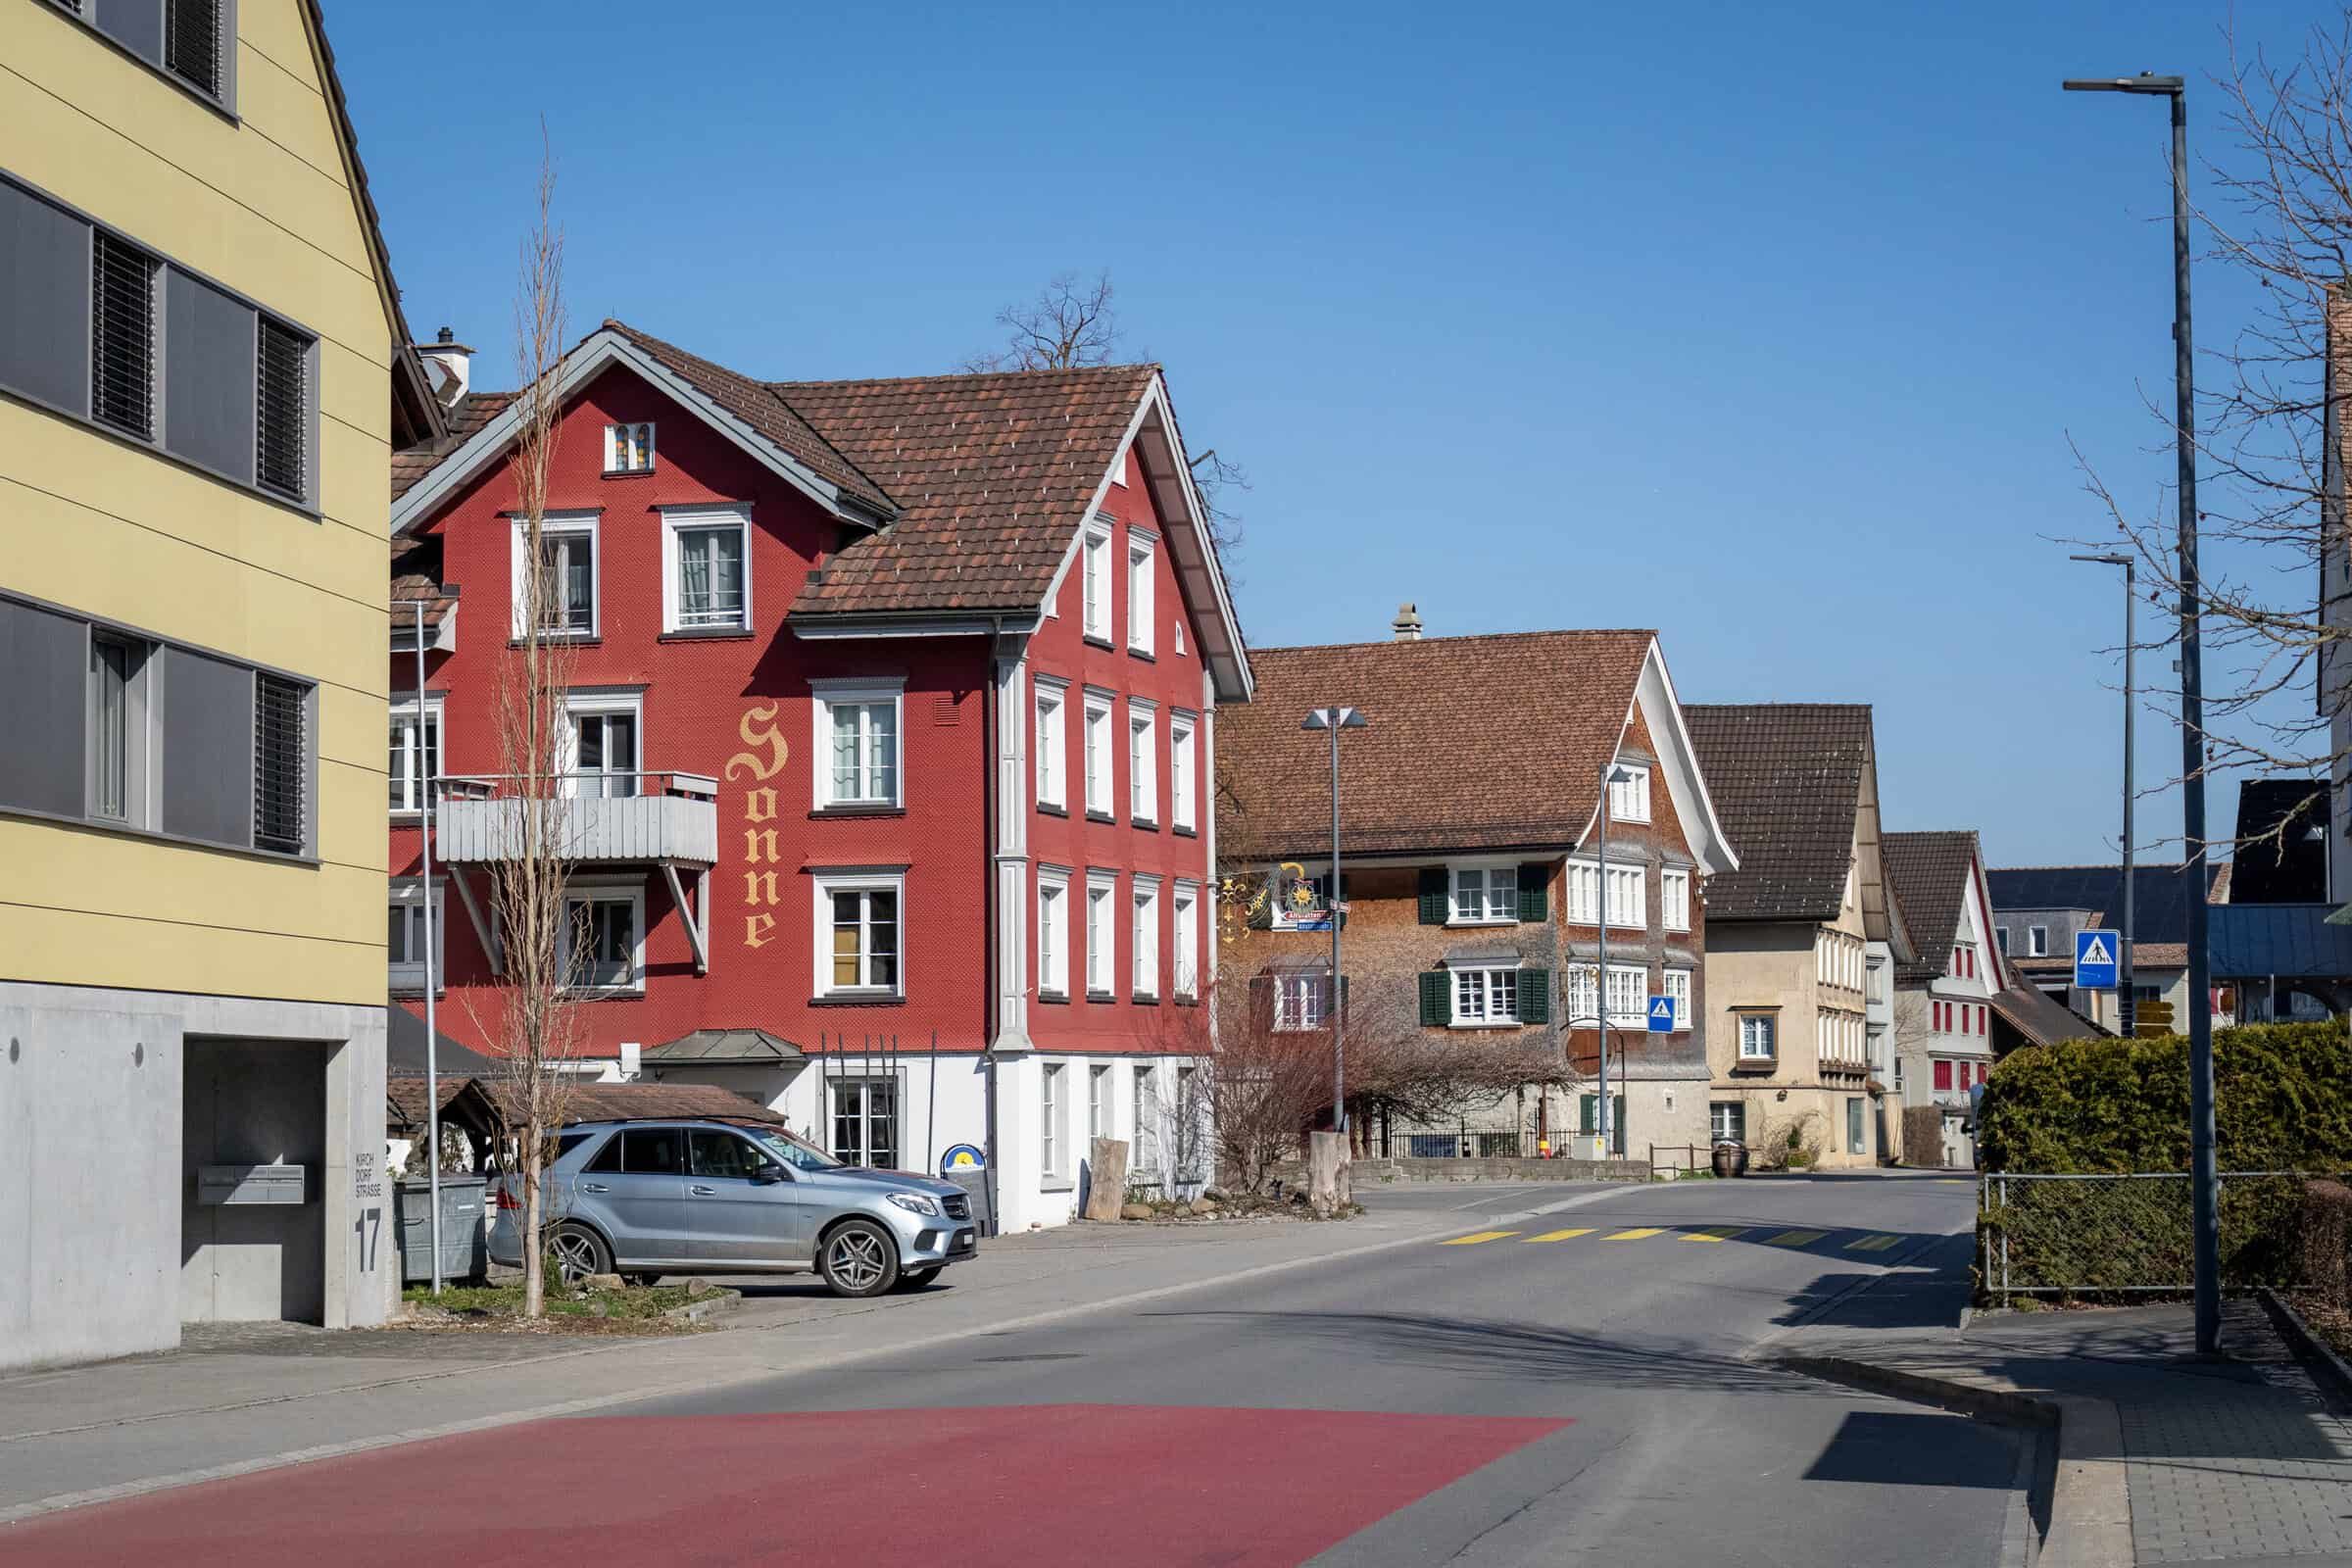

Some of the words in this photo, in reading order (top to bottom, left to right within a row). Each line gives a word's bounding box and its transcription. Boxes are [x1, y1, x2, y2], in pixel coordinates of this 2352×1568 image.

[724, 701, 789, 949] Sonne
[355, 1152, 374, 1168] KIRCH
[355, 1168, 372, 1183] DORF
[355, 1183, 381, 1199] STRASSE
[355, 1207, 381, 1272] 17
